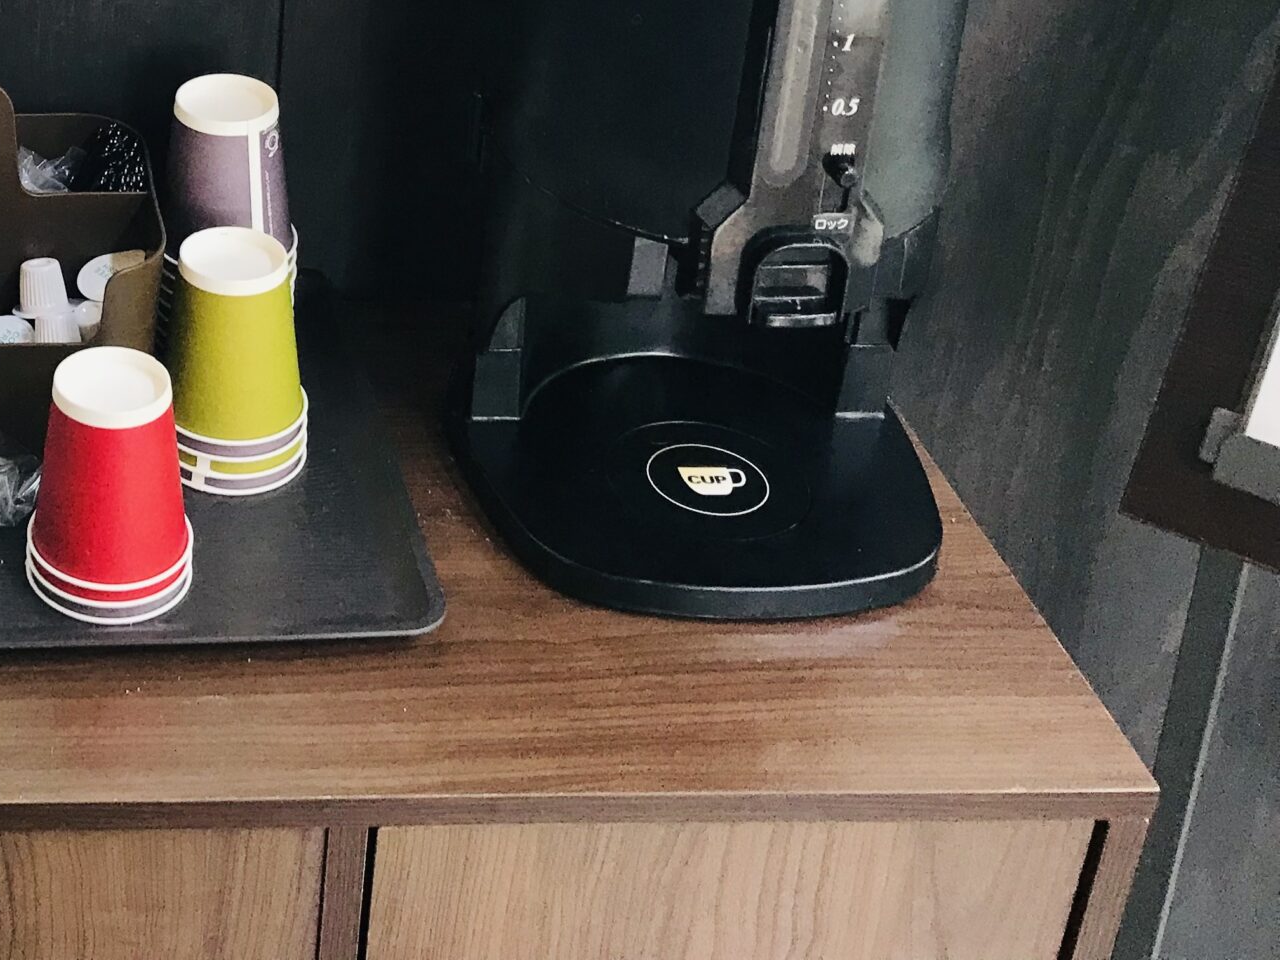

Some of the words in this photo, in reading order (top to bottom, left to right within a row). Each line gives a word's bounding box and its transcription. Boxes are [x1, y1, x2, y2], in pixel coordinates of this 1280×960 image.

[842, 34, 855, 52] 1
[831, 98, 860, 116] 0.5
[815, 219, 849, 230] ロック
[687, 475, 727, 484] CUP
